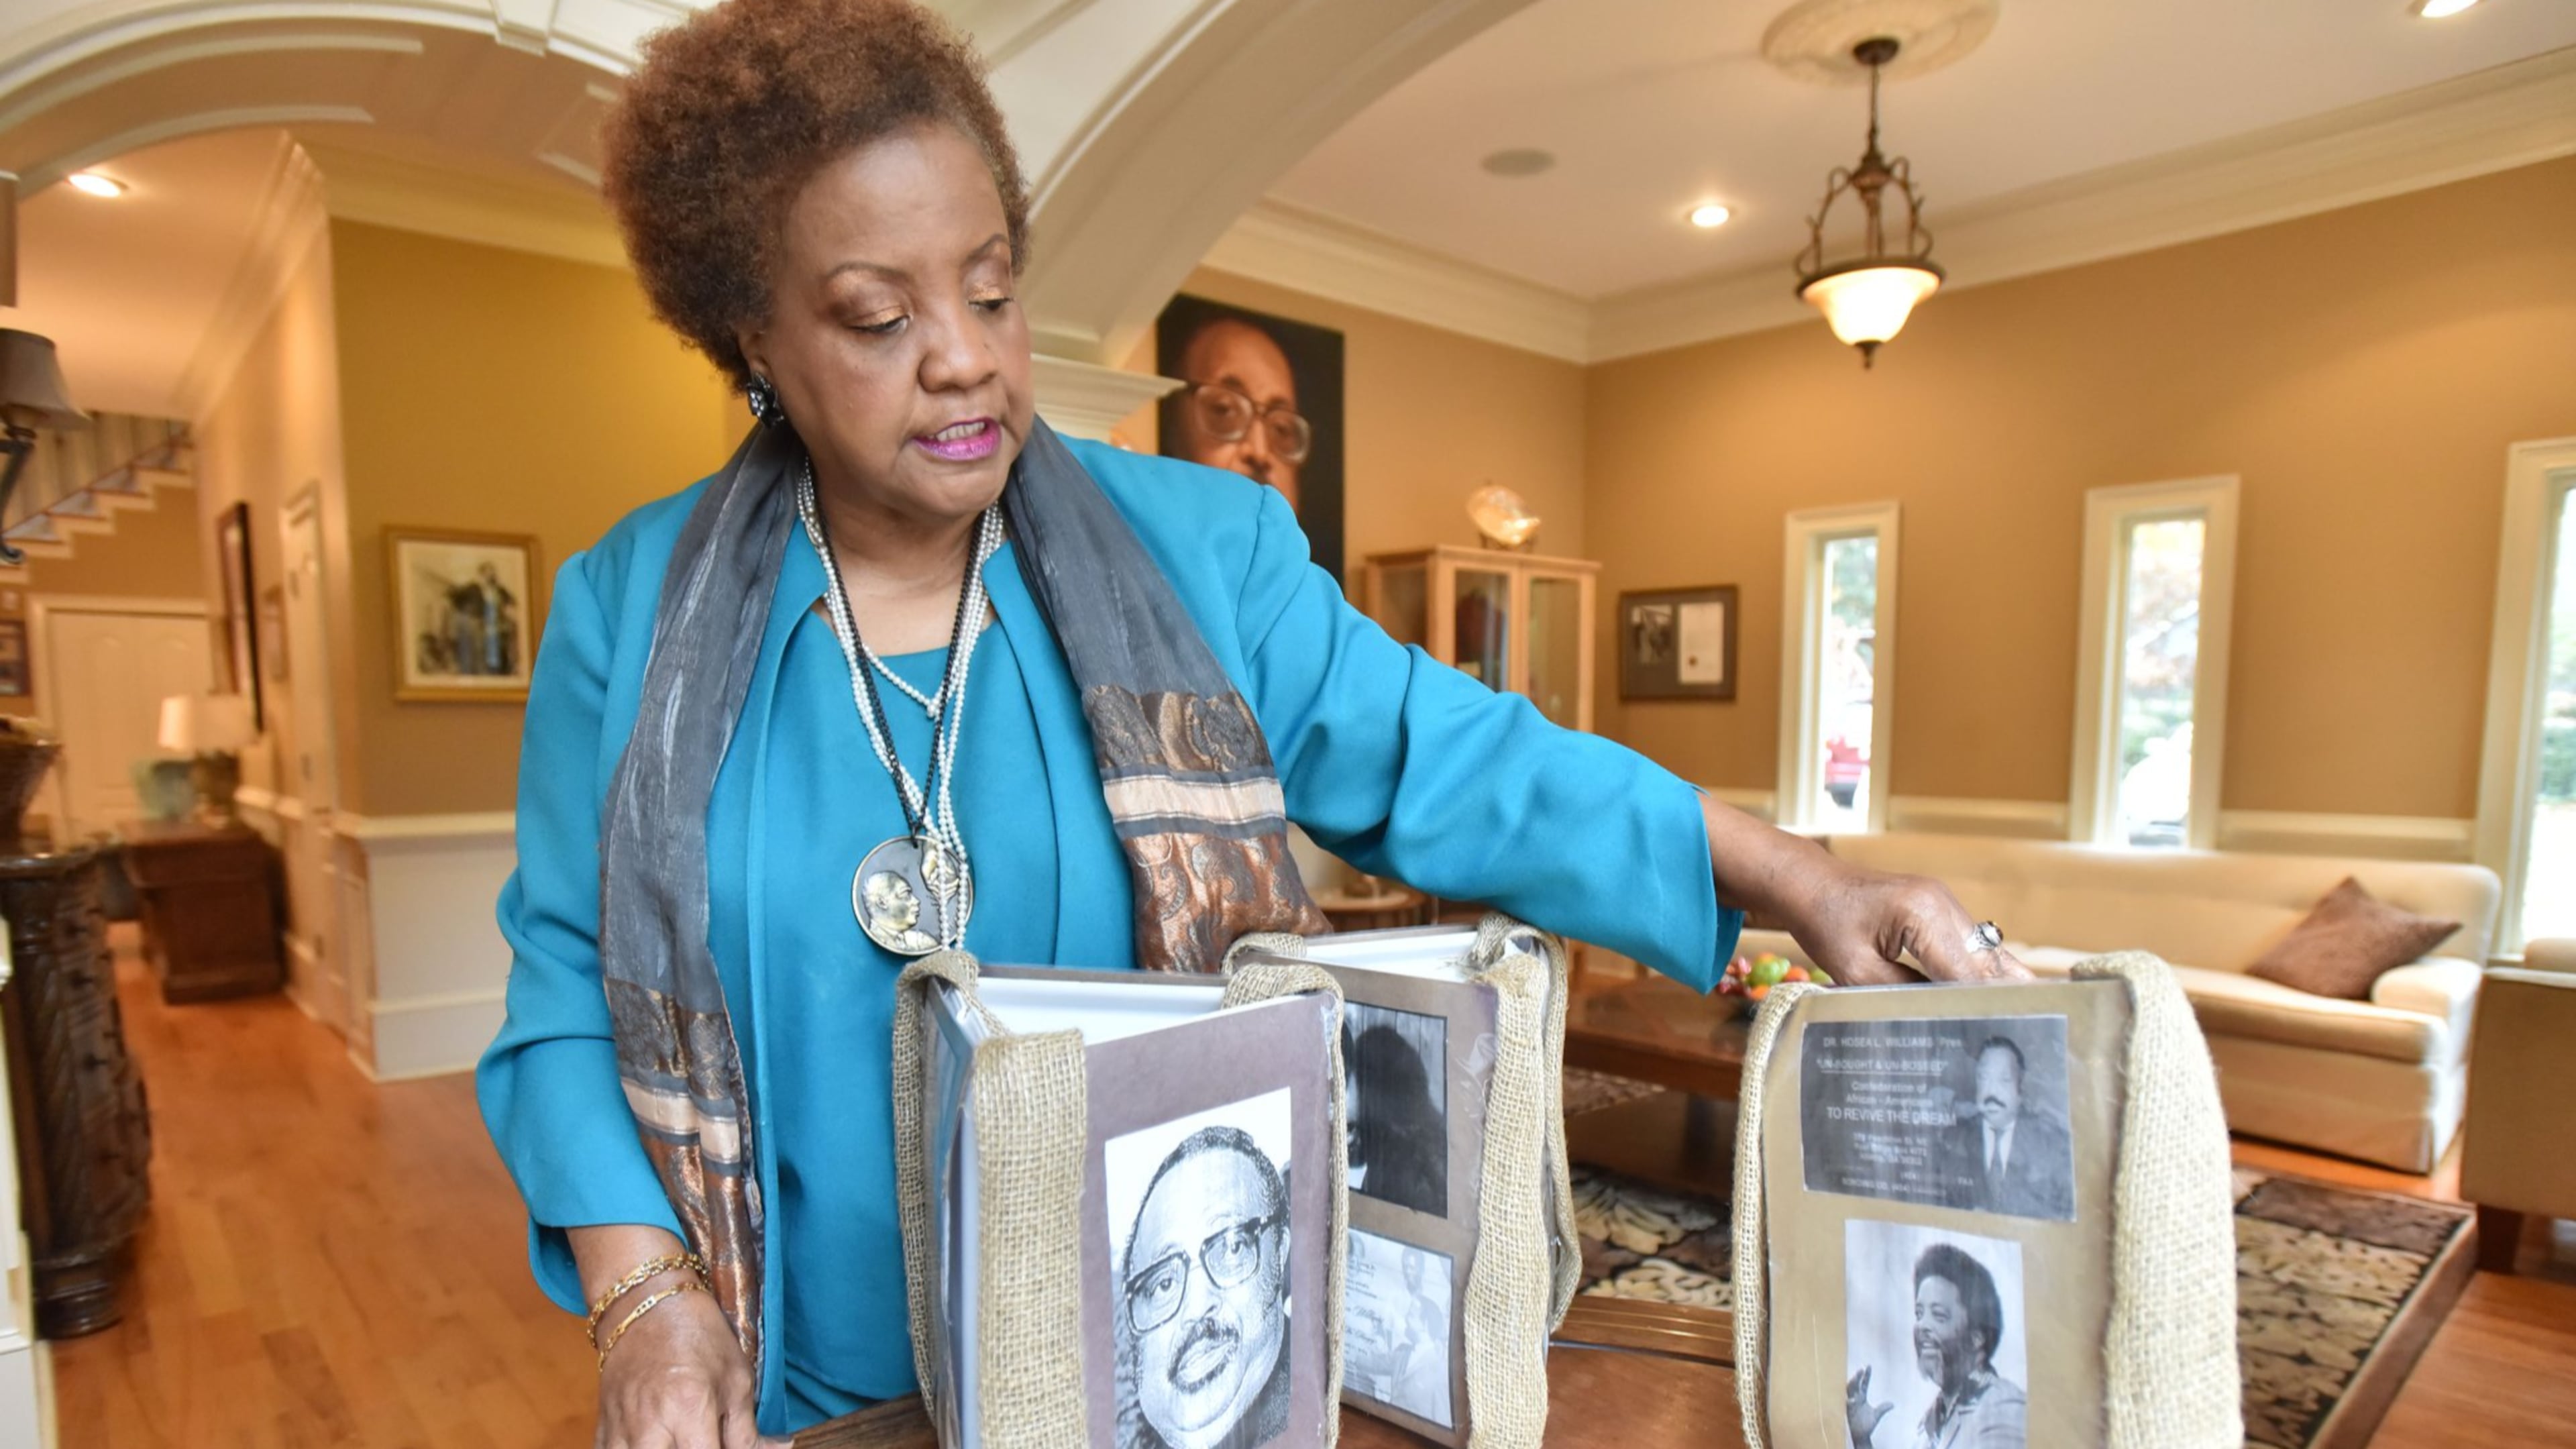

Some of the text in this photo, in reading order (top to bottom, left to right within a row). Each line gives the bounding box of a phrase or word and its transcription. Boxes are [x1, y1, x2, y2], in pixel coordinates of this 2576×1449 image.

[1841, 1037, 1872, 1047] HOSEA
[1886, 1037, 1933, 1048] WILLIAMS
[1827, 1106, 1957, 1126] TO REVIVE THE DREAM
